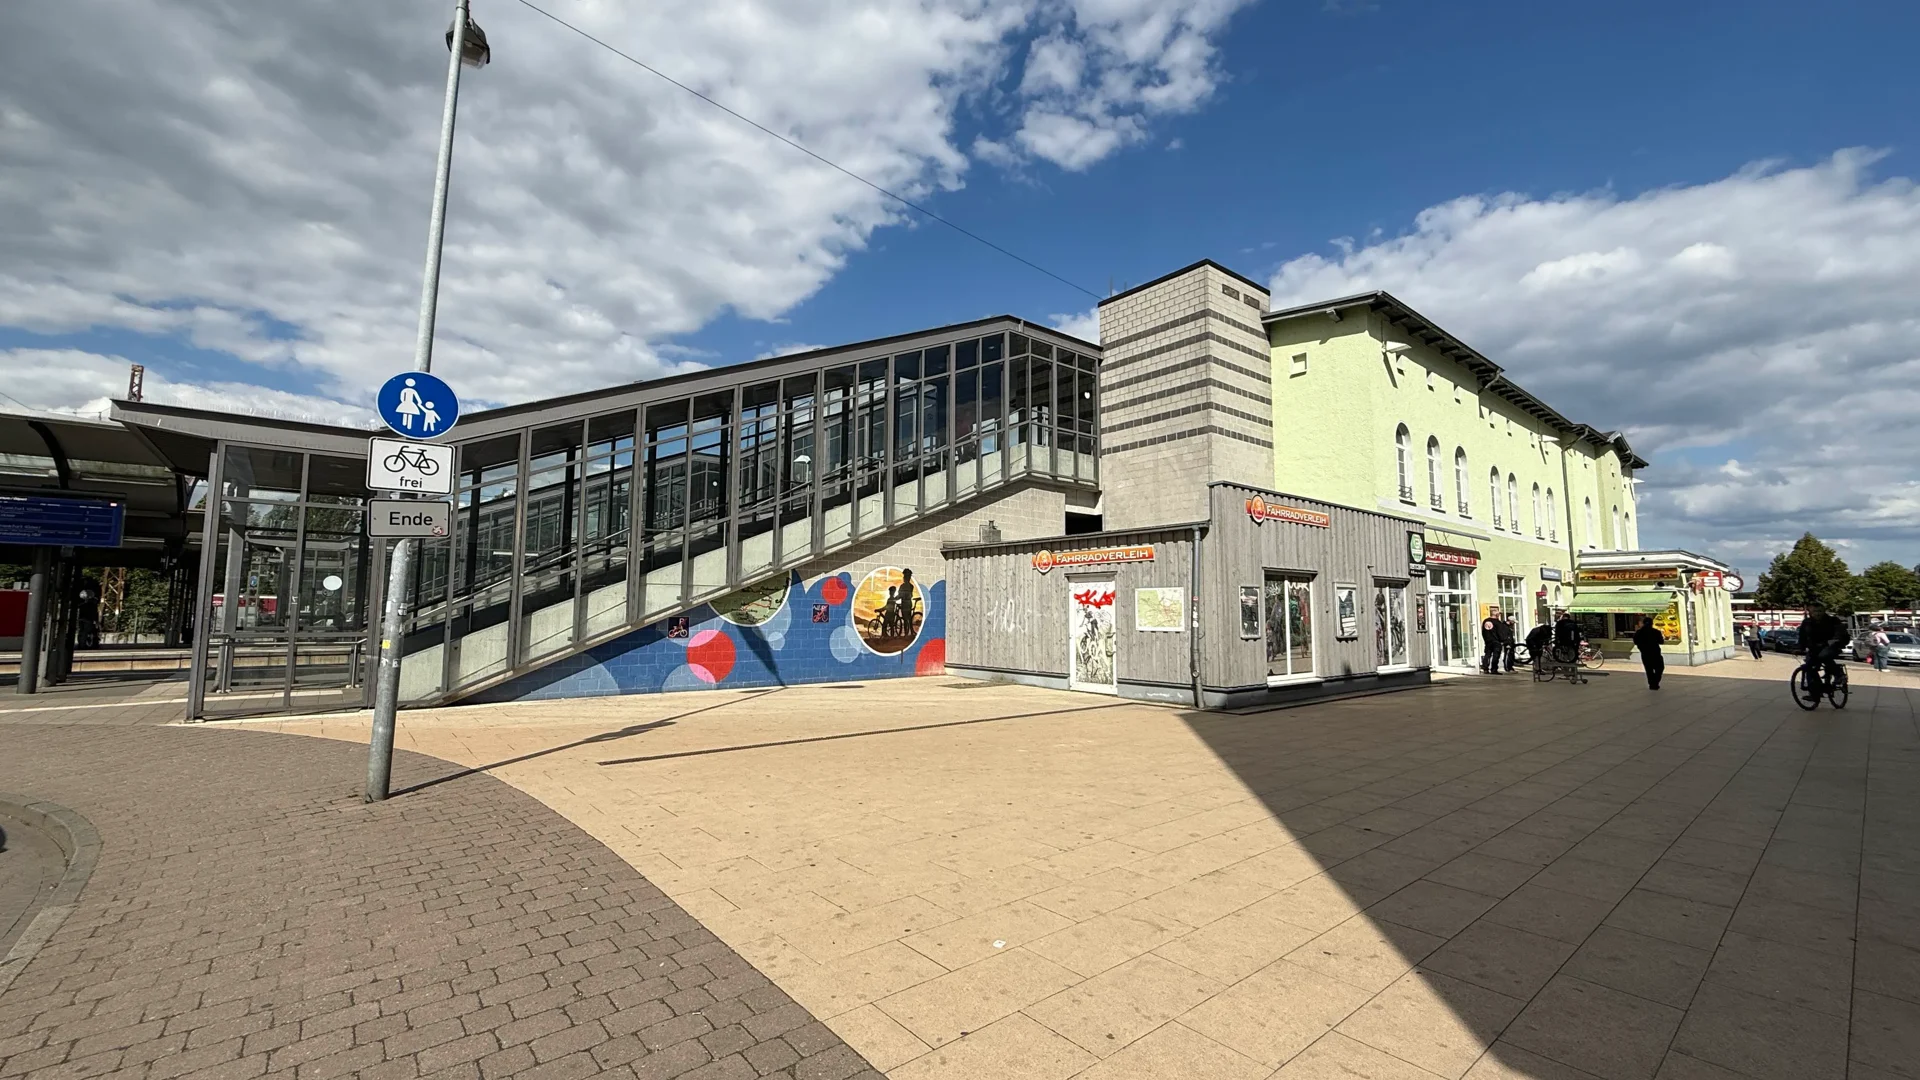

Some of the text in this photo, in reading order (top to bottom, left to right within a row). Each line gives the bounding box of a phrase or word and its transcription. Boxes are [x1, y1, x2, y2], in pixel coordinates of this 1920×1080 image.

[400, 476, 422, 488] frei
[389, 511, 433, 526] Ende
[1266, 505, 1327, 524] FAHRRADVERLEIH
[1056, 549, 1149, 564] FAHRRADVERLEIH
[1607, 571, 1646, 579] Vita Bar
